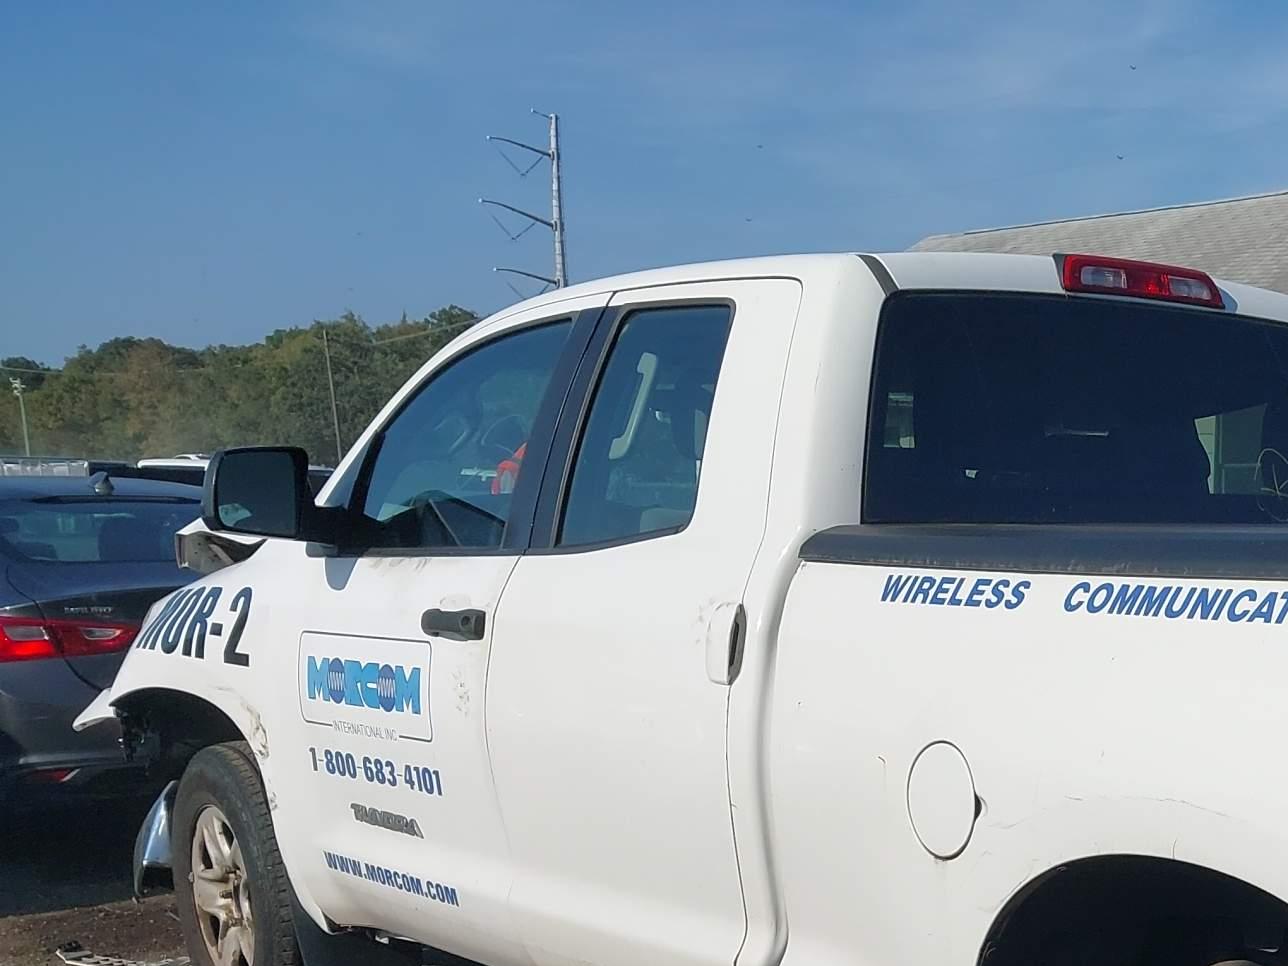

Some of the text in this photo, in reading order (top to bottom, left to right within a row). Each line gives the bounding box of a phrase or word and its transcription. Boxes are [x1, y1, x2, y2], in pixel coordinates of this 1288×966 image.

[881, 575, 1031, 610] WIRELESS
[136, 586, 253, 668] MOR-2
[307, 655, 422, 716] MORCOM
[333, 719, 385, 740] INTERNATIONAL
[308, 747, 443, 797] 1-800-683-4101
[322, 849, 460, 907] WWW.MORCOM.COM
